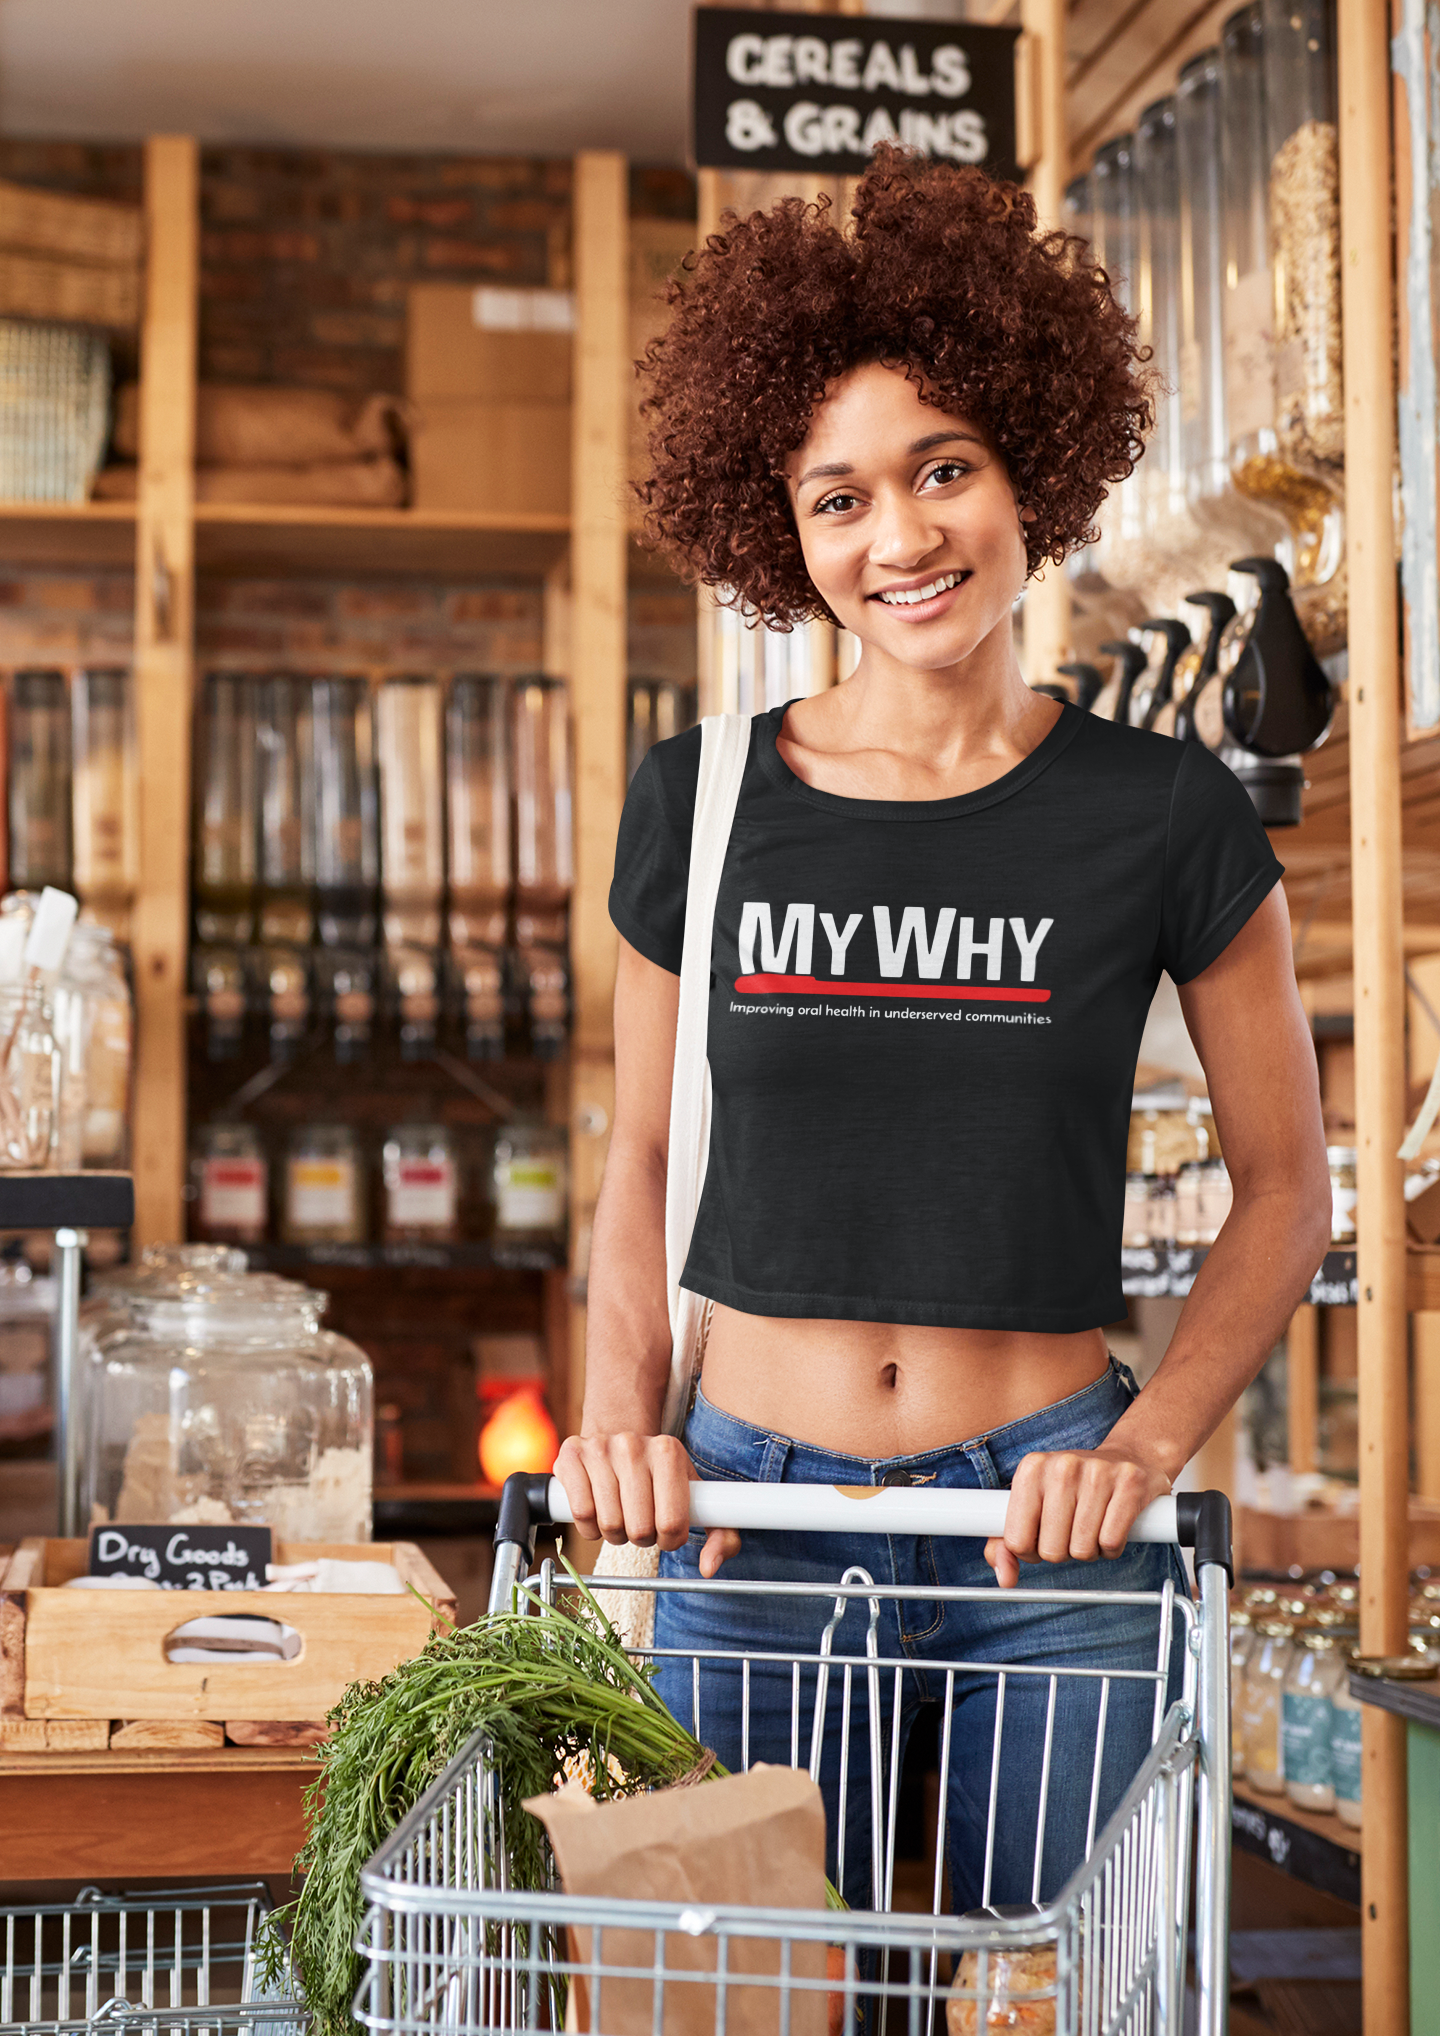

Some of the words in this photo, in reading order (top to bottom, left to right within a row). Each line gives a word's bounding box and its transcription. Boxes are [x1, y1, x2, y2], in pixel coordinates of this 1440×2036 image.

[726, 33, 971, 98] CEREALS
[725, 99, 777, 152] &
[783, 101, 988, 164] GRAINS
[729, 1001, 795, 1018] Improving
[797, 1003, 823, 1017] oral
[825, 1004, 866, 1018] health
[869, 1006, 881, 1018] in
[884, 1007, 962, 1022] underserved
[965, 1012, 1053, 1025] communities
[97, 1531, 161, 1579] Dry
[165, 1532, 250, 1567] Goods
